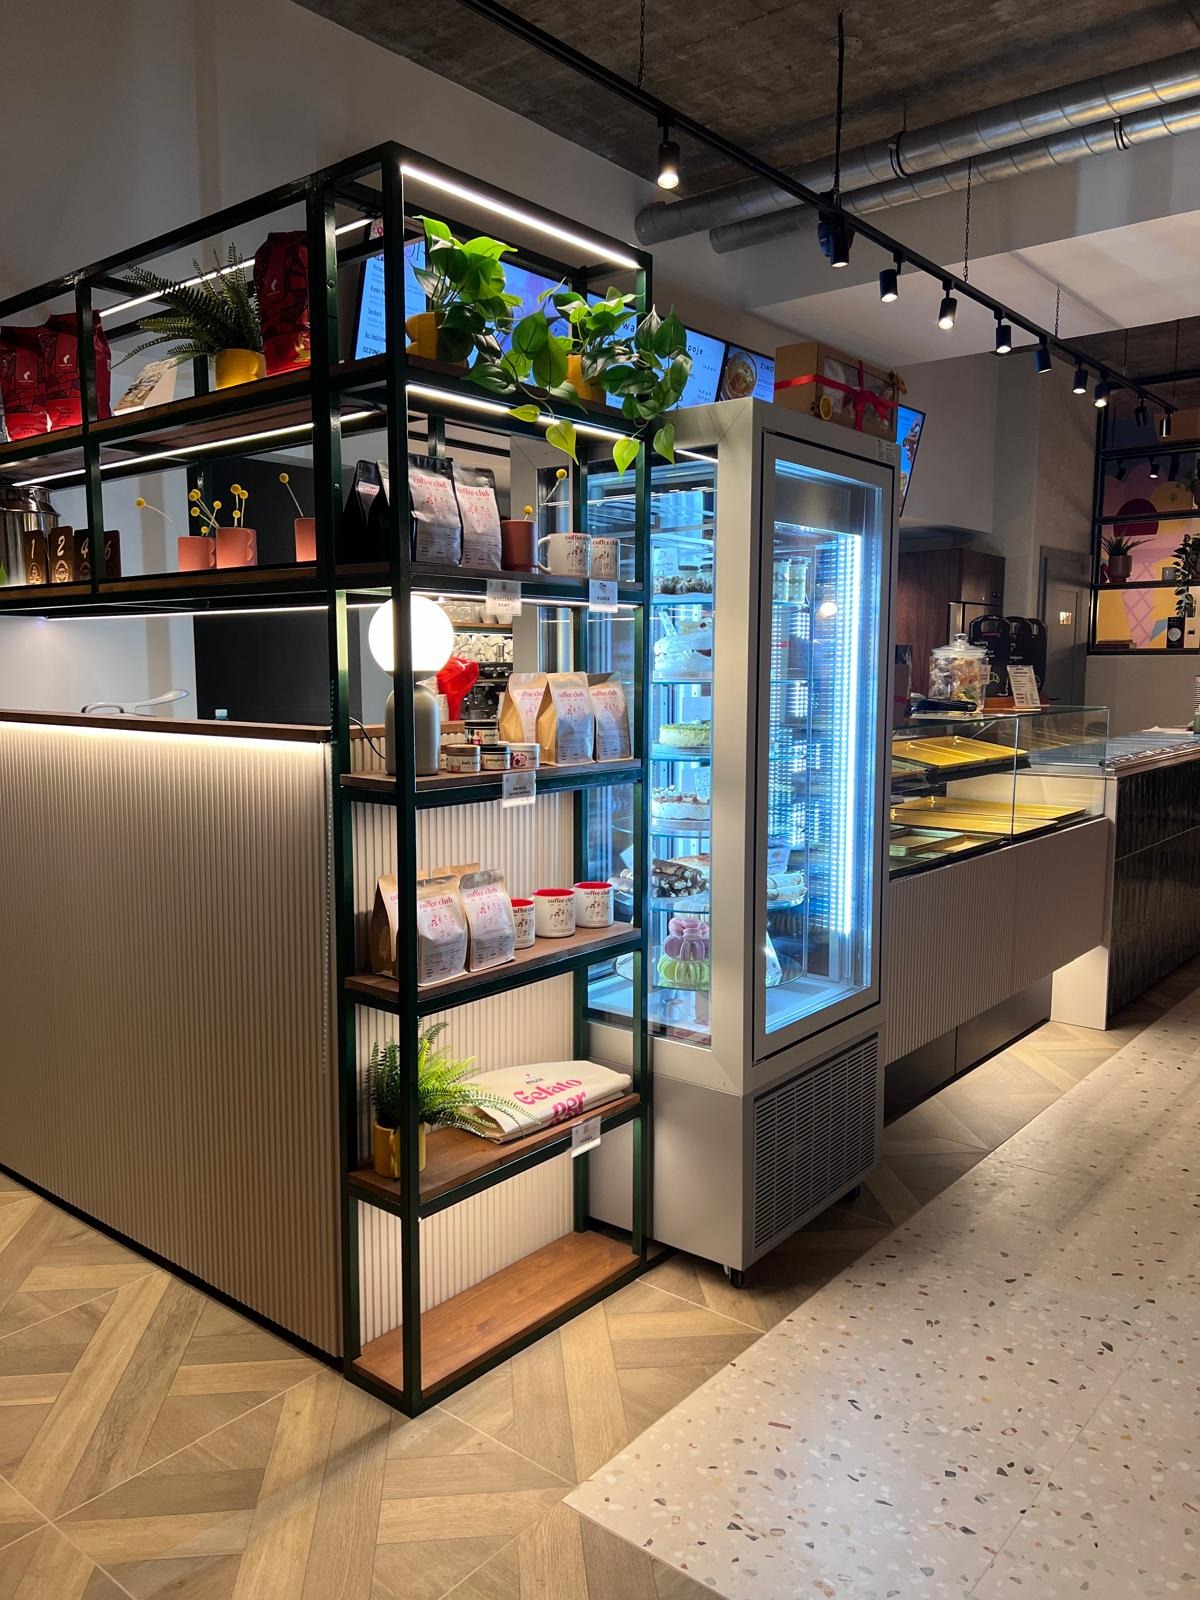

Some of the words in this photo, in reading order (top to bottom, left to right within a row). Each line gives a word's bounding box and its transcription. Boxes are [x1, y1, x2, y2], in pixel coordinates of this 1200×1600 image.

[687, 344, 704, 355] poje
[760, 363, 775, 373] ZIMO
[31, 538, 36, 559] 1
[57, 535, 66, 557] 2
[80, 537, 89, 559] 4
[104, 540, 112, 561] 6
[419, 900, 438, 910] coffee
[438, 896, 453, 906] club
[466, 889, 484, 899] coffee
[484, 887, 498, 896] club
[547, 897, 564, 905] coffee
[513, 1079, 582, 1105] Gelato
[551, 1090, 586, 1117] per
